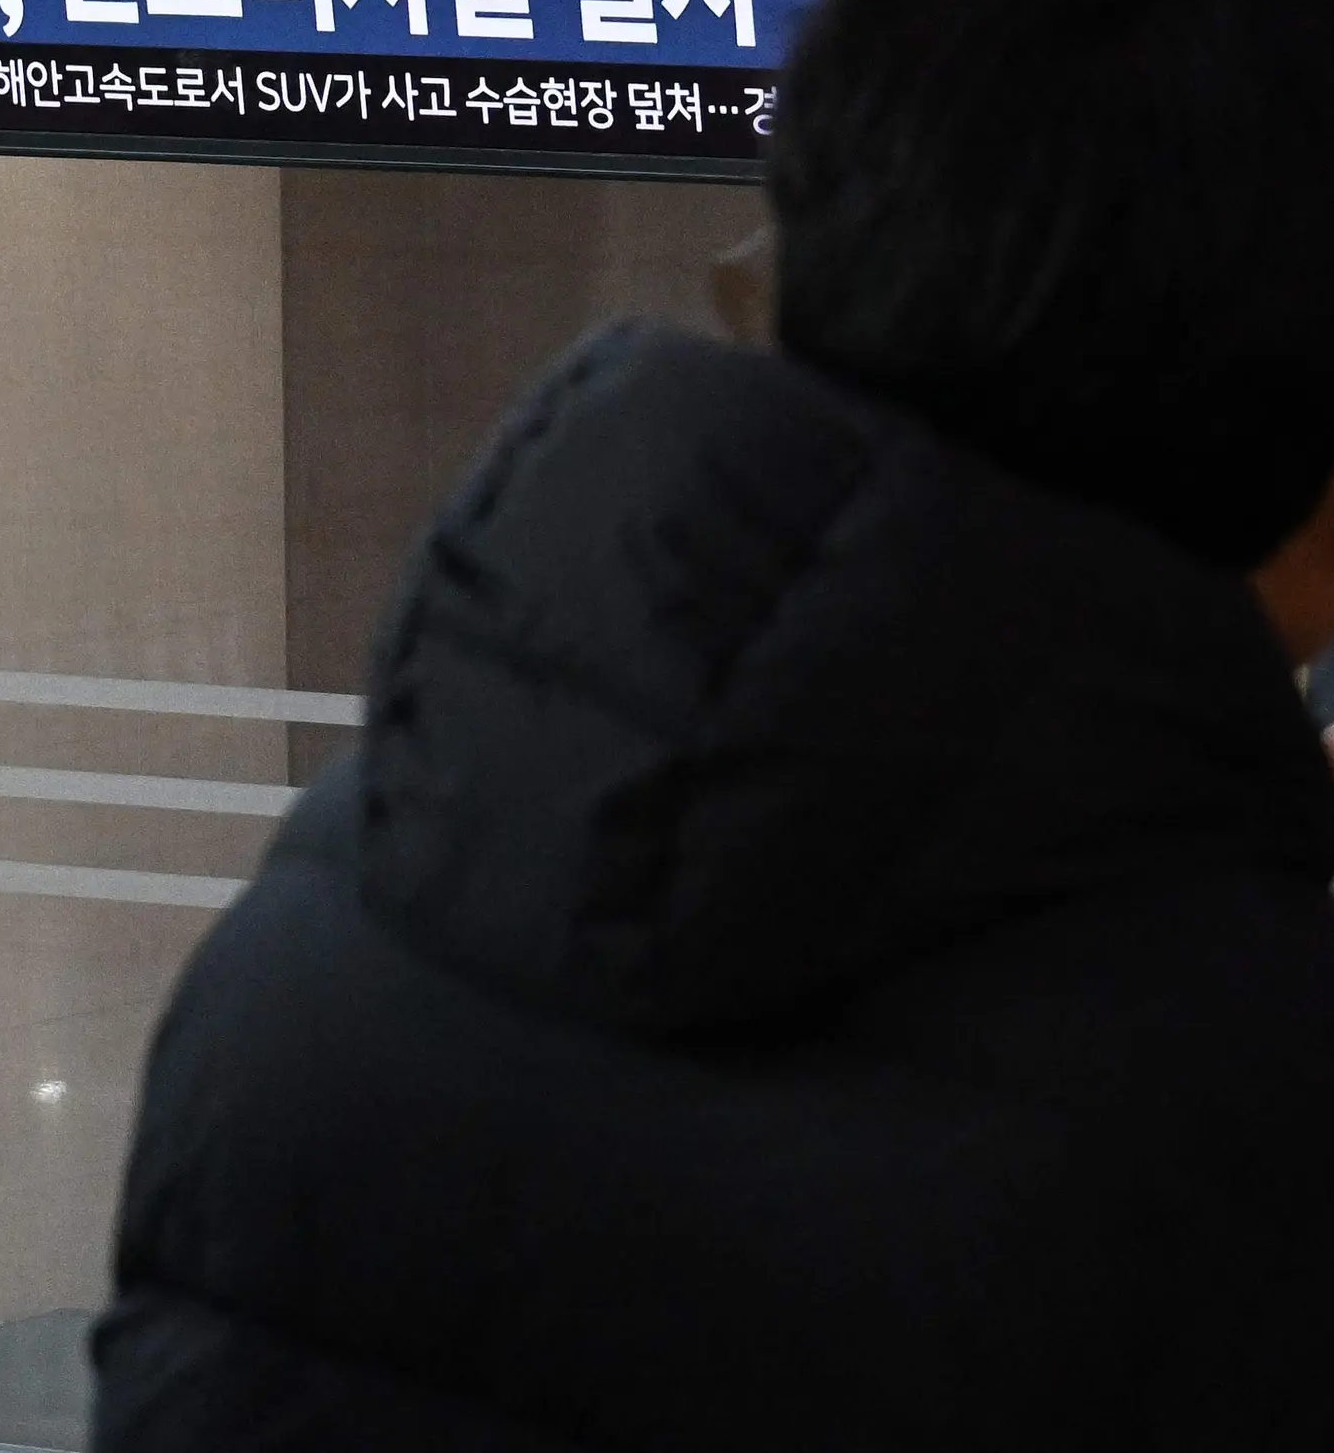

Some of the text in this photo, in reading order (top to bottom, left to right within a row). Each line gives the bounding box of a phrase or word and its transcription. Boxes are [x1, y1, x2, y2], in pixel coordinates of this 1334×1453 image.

[258, 73, 369, 120] SUV가
[381, 71, 458, 122] 사고
[466, 76, 617, 132] 수습현장
